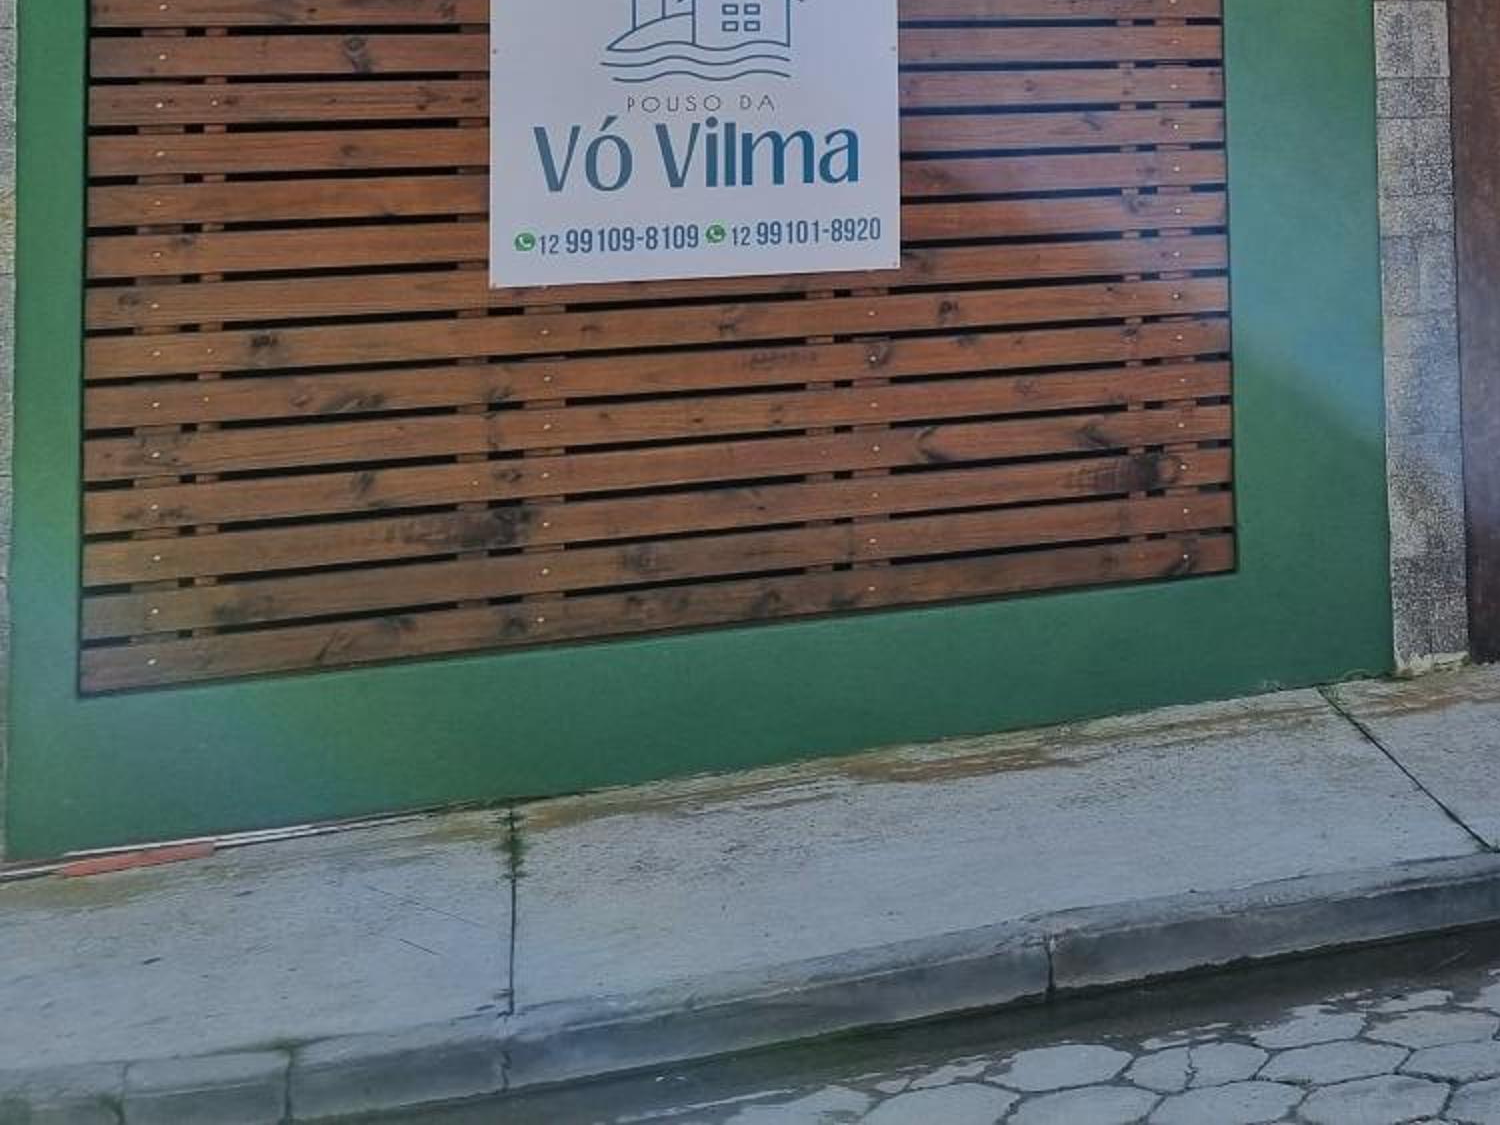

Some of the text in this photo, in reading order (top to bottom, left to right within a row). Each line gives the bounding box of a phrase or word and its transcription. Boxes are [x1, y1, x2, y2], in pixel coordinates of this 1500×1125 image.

[627, 94, 775, 112] POUSO DA
[533, 115, 860, 192] Vó Vilma
[540, 217, 881, 254] 12 99109-8109 12 99101-8920
